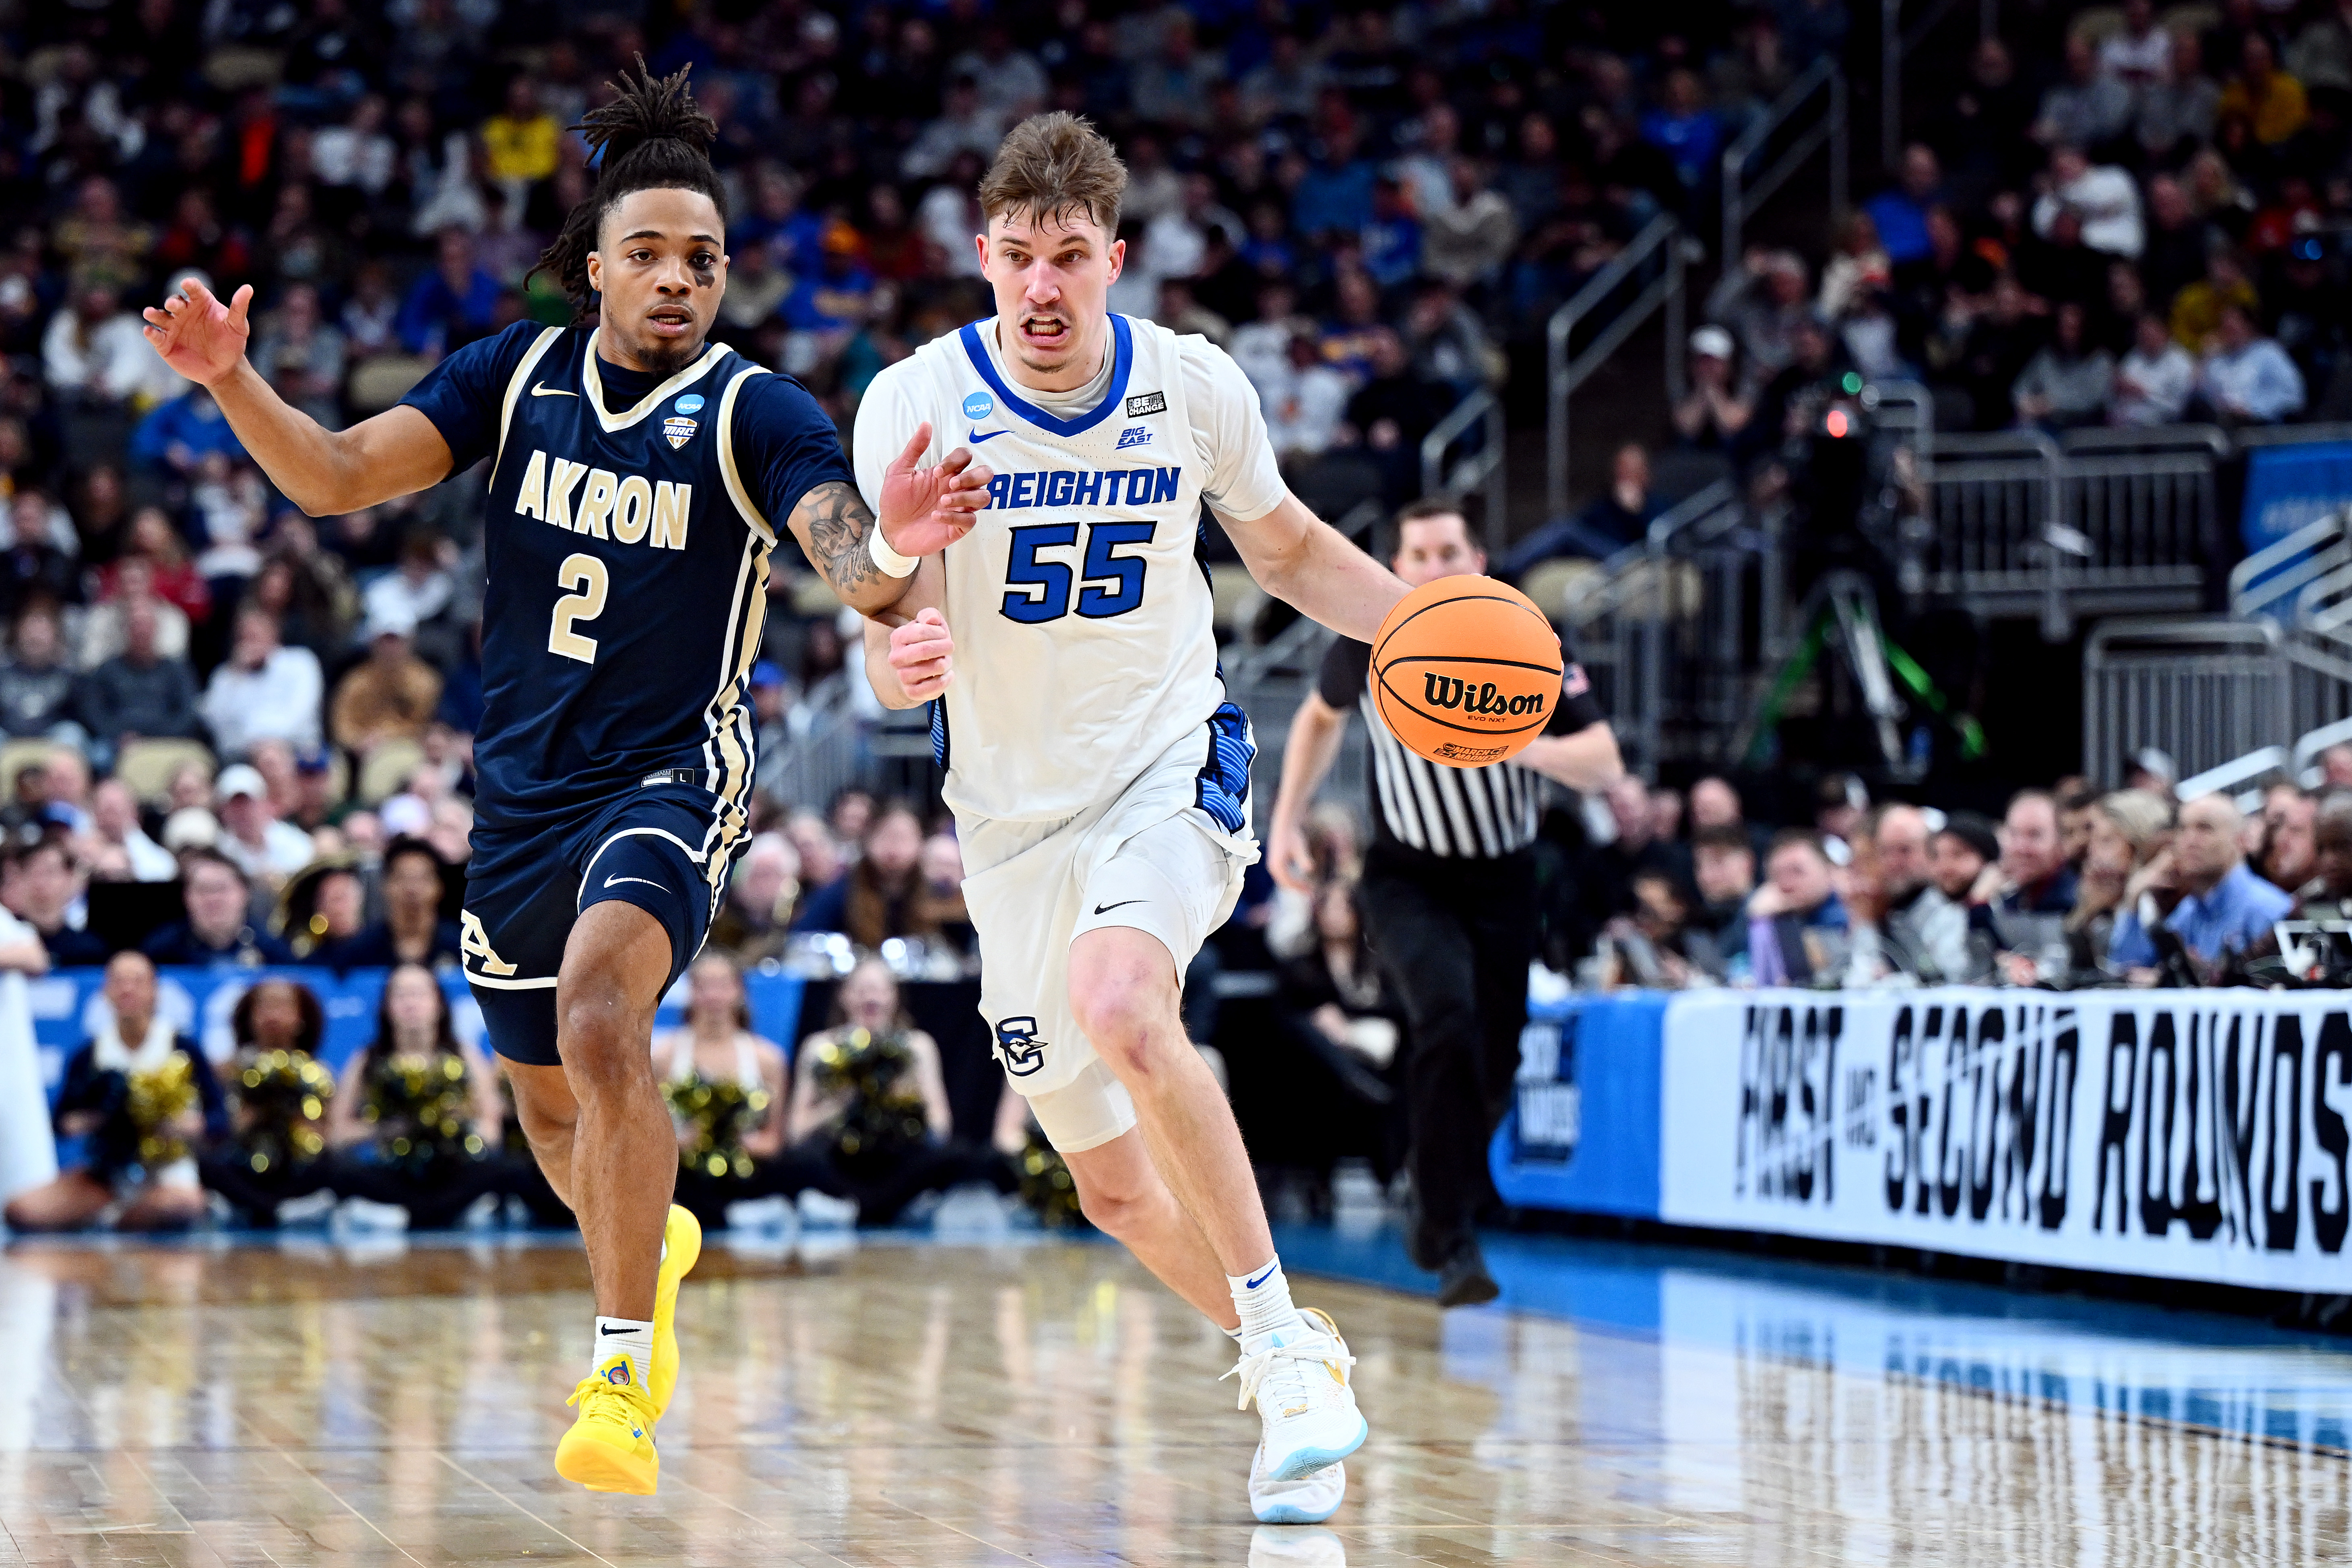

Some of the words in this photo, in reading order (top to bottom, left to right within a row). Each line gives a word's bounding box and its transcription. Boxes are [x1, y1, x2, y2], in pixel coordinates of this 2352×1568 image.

[967, 403, 990, 413] NCAA
[1129, 402, 1164, 415] CHANGE
[663, 426, 696, 436] MAC
[1121, 426, 1146, 438] BIG
[1117, 434, 1153, 445] EAST
[981, 467, 1181, 510] REIGHTON
[515, 449, 692, 551] AKRON
[998, 521, 1158, 624] 55
[548, 552, 609, 665] 2
[1423, 671, 1544, 715] Wilson
[1452, 746, 1491, 756] MARCH
[1453, 752, 1503, 762] MADNESS
[680, 773, 686, 782] L
[461, 909, 518, 976] A
[1735, 1004, 1843, 1206] FIRST
[1884, 1004, 2079, 1232] SECOND
[2091, 1011, 2352, 1253] ROUNDS
